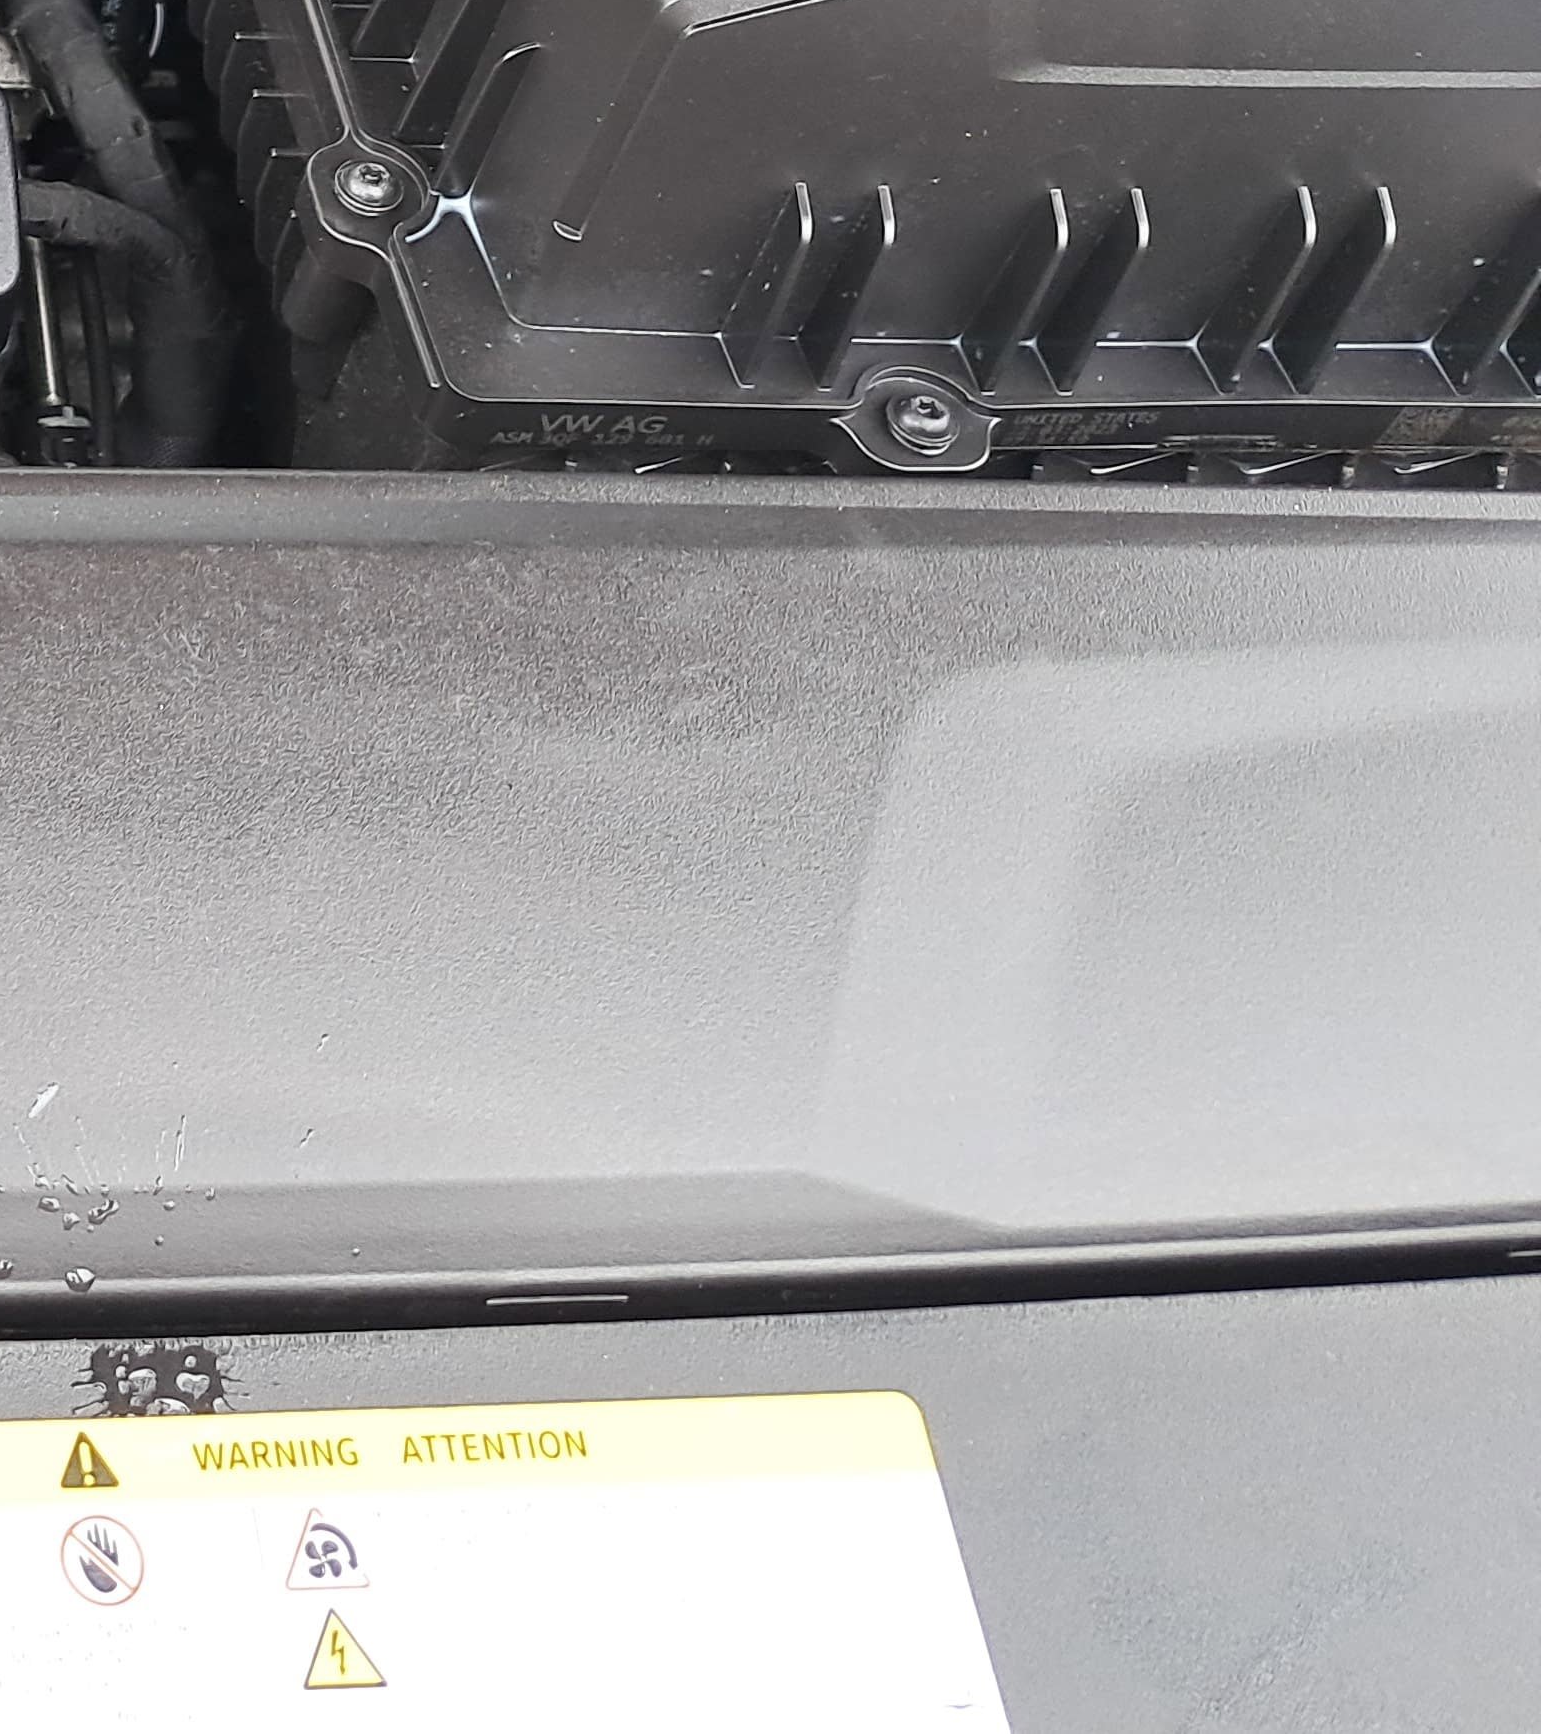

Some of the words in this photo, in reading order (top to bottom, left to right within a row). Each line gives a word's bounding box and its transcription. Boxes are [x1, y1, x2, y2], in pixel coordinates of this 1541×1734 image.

[539, 412, 605, 434] VW
[611, 414, 669, 435] AG
[192, 1437, 360, 1472] WARNING
[402, 1430, 589, 1465] ATTENTION
